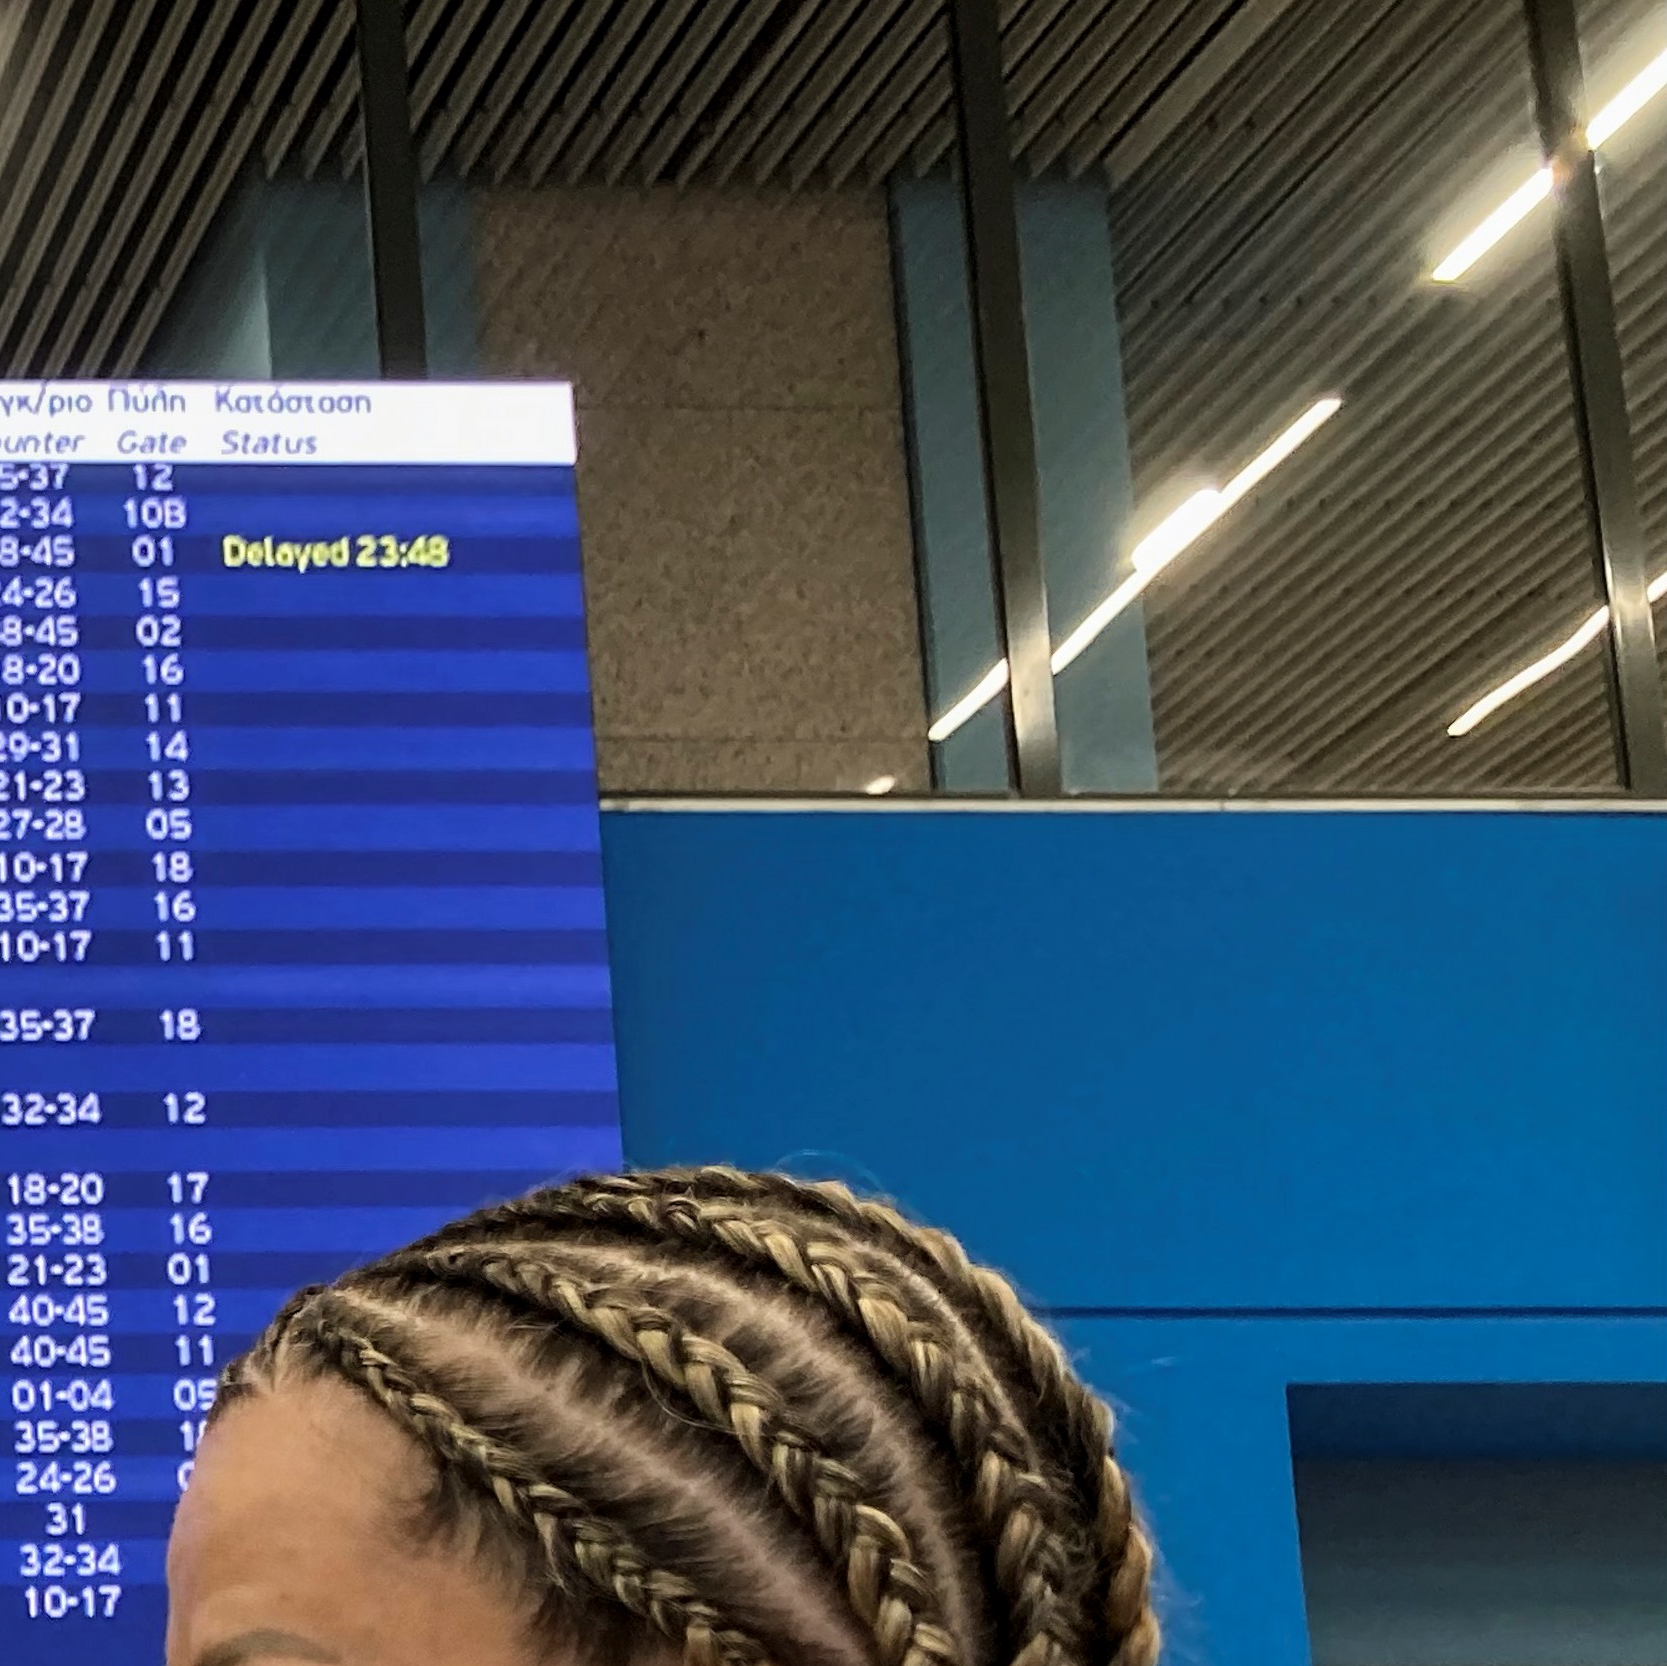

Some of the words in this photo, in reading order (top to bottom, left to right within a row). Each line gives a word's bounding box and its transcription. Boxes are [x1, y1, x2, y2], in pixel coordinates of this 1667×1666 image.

[117, 430, 187, 454] Gate
[221, 430, 318, 454] Status
[124, 497, 187, 529] 10B
[132, 535, 173, 567] 01
[222, 534, 350, 573] Delayed
[356, 534, 451, 567] 23:48
